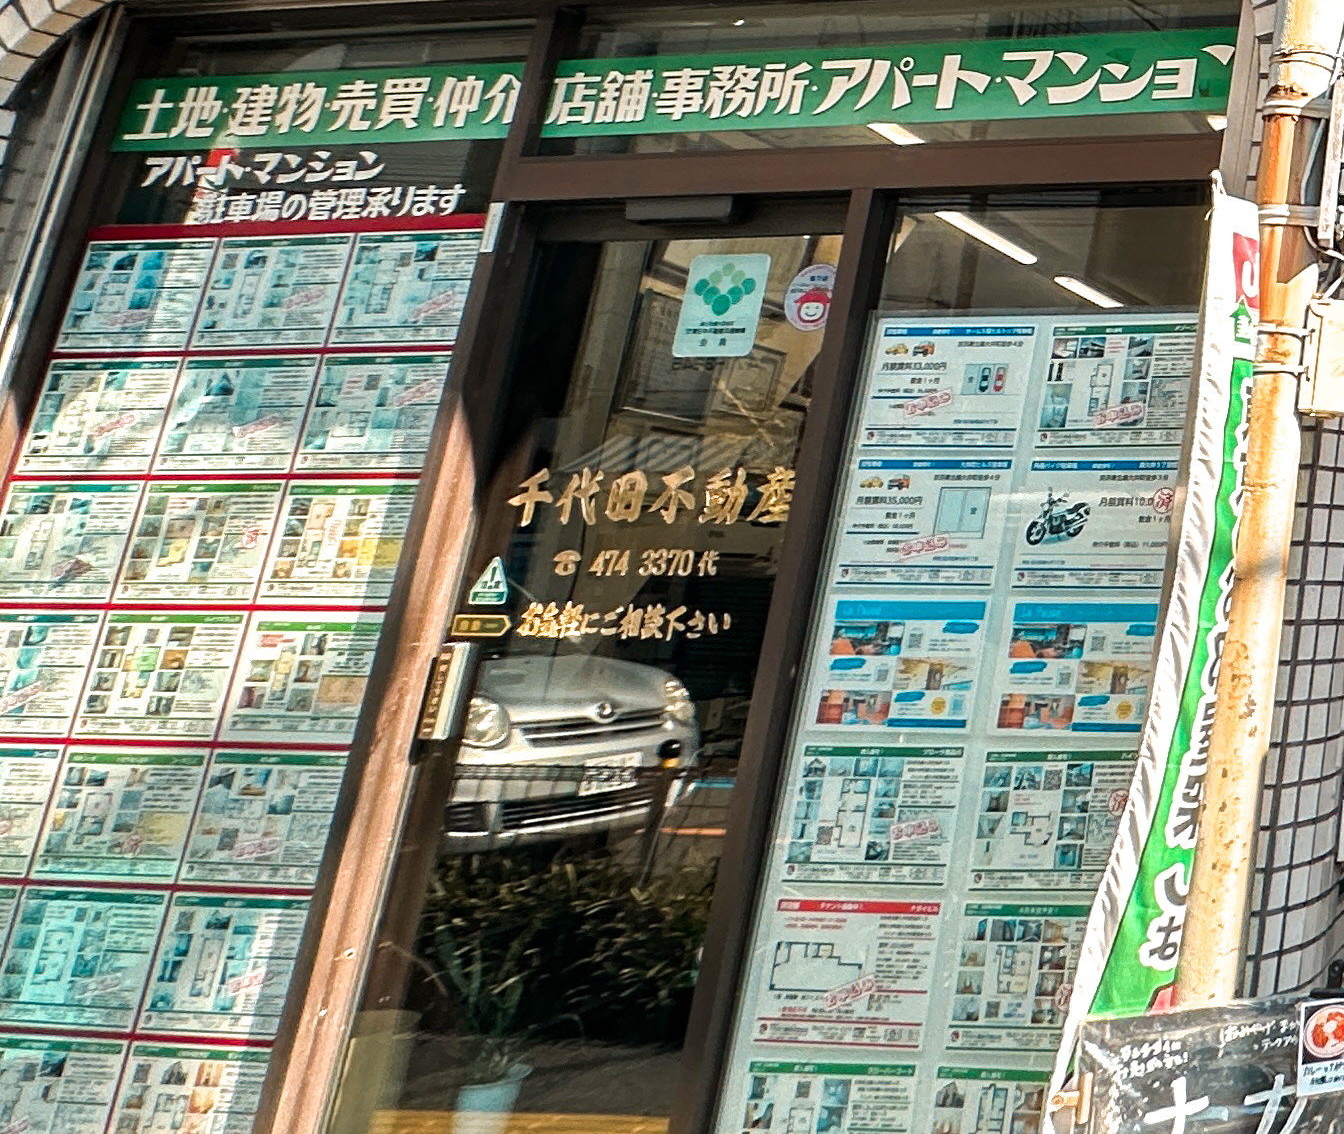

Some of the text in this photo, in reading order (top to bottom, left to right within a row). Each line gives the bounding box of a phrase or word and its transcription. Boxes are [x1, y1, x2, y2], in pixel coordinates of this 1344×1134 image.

[140, 150, 386, 189] アパート・マンション
[190, 183, 467, 226] 駐車場の管理承ります
[507, 465, 796, 528] 千代田不動産
[589, 549, 630, 577] 474
[638, 549, 694, 577] 3370
[516, 600, 732, 642] お気軽にご相談下さい
